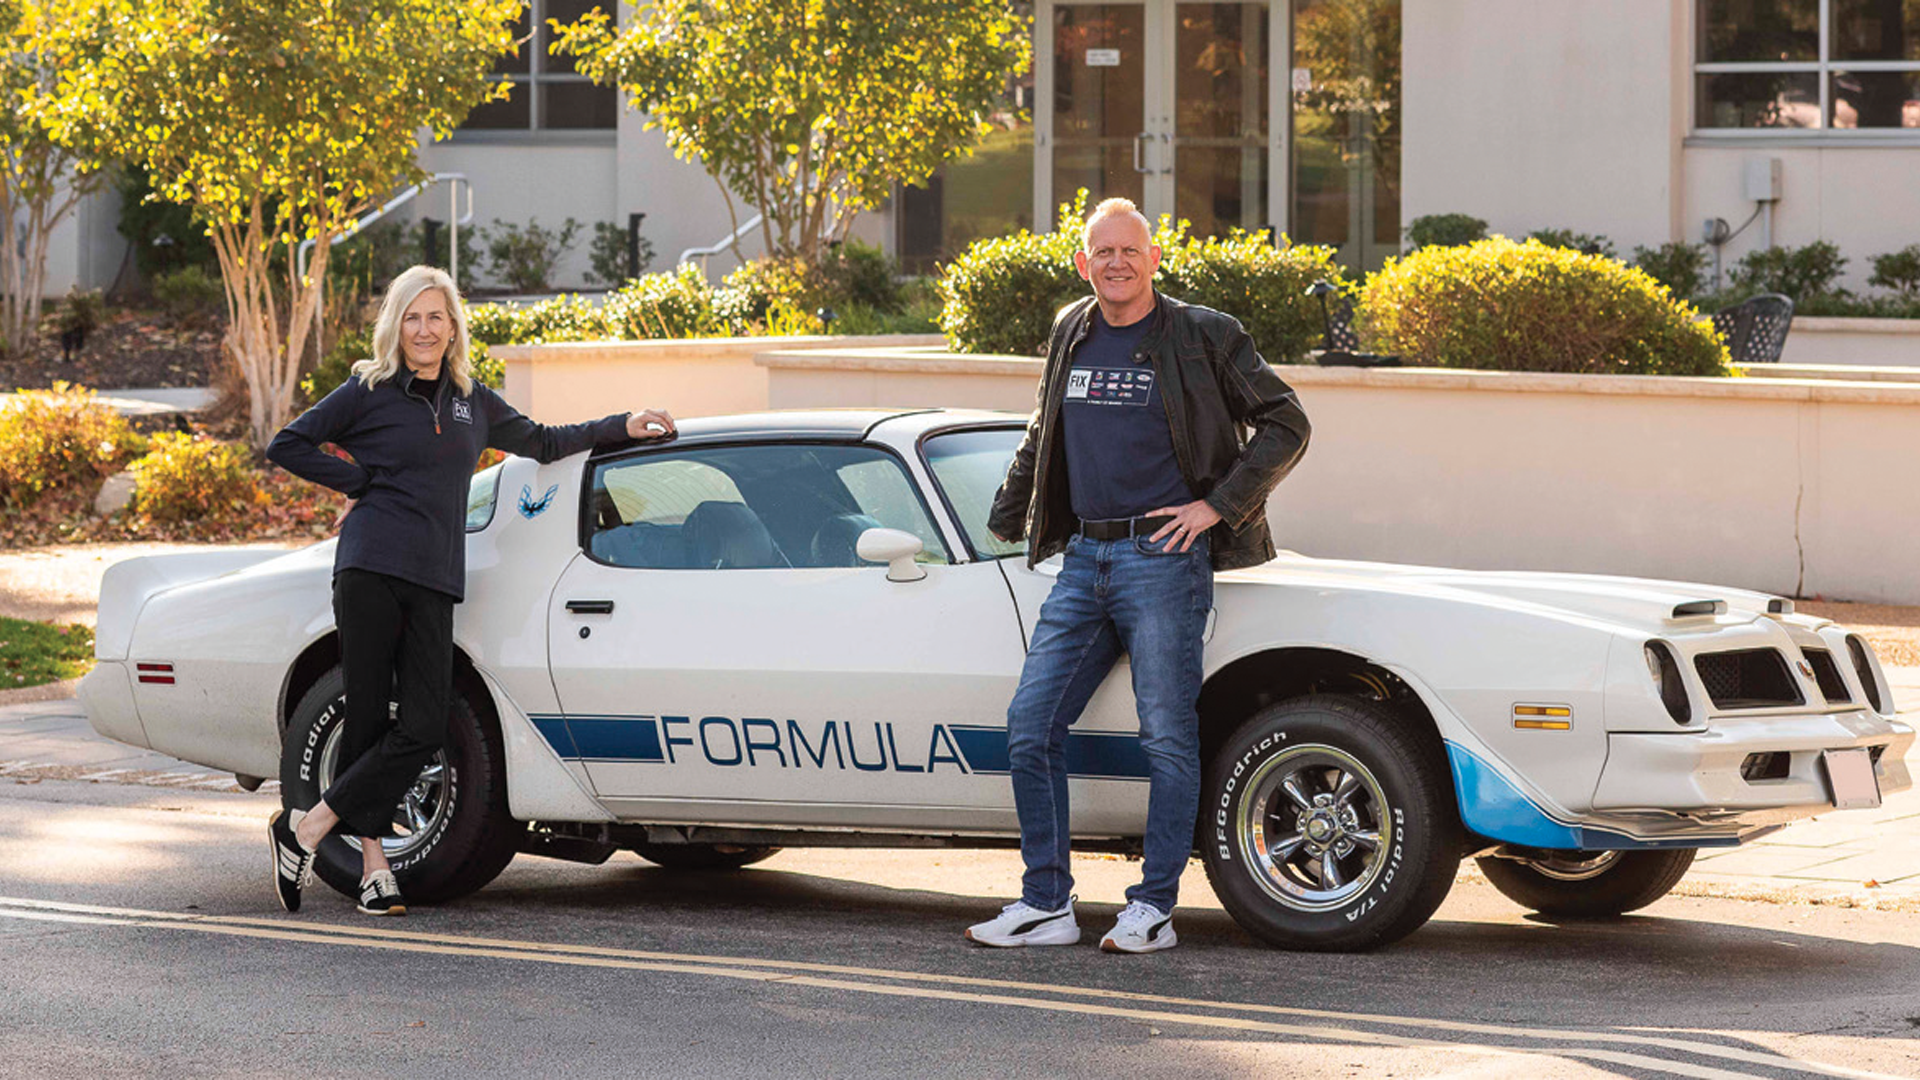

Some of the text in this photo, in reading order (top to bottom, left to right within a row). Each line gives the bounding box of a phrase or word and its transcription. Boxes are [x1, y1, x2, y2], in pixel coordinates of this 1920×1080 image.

[1070, 374, 1088, 388] FIX
[300, 704, 336, 782] Radial
[662, 715, 969, 774] FORMULA
[392, 767, 458, 872] BFGoodric
[1216, 730, 1287, 860] BFGoodrich
[1345, 896, 1379, 922] T/A
